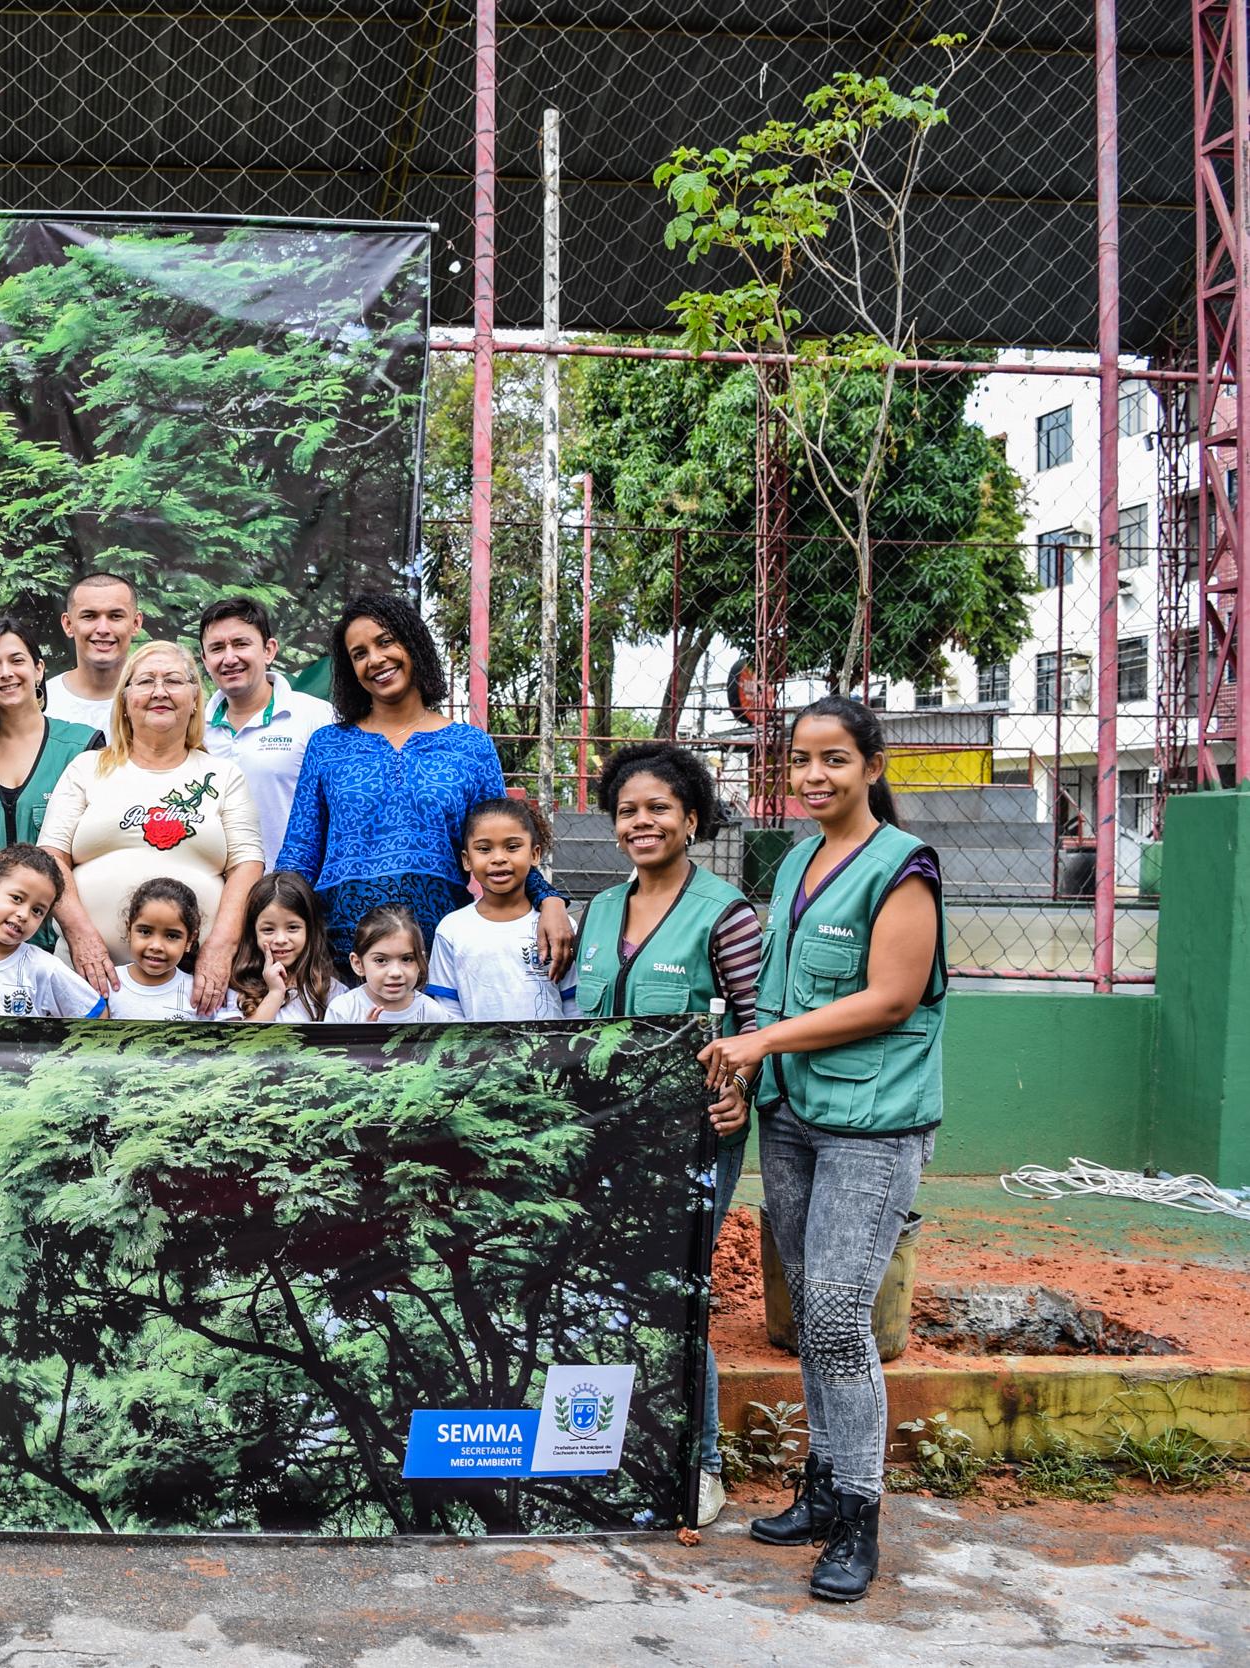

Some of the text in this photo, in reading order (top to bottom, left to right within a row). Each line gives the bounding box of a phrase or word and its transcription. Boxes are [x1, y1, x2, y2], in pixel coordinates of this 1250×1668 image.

[120, 805, 151, 830] Par
[818, 924, 854, 938] SEMMA
[653, 963, 686, 974] SEMMA
[437, 1423, 523, 1443] SEMMA
[461, 1446, 523, 1455] SECRETARIA DE
[450, 1457, 522, 1467] MEIO AMBIENTE
